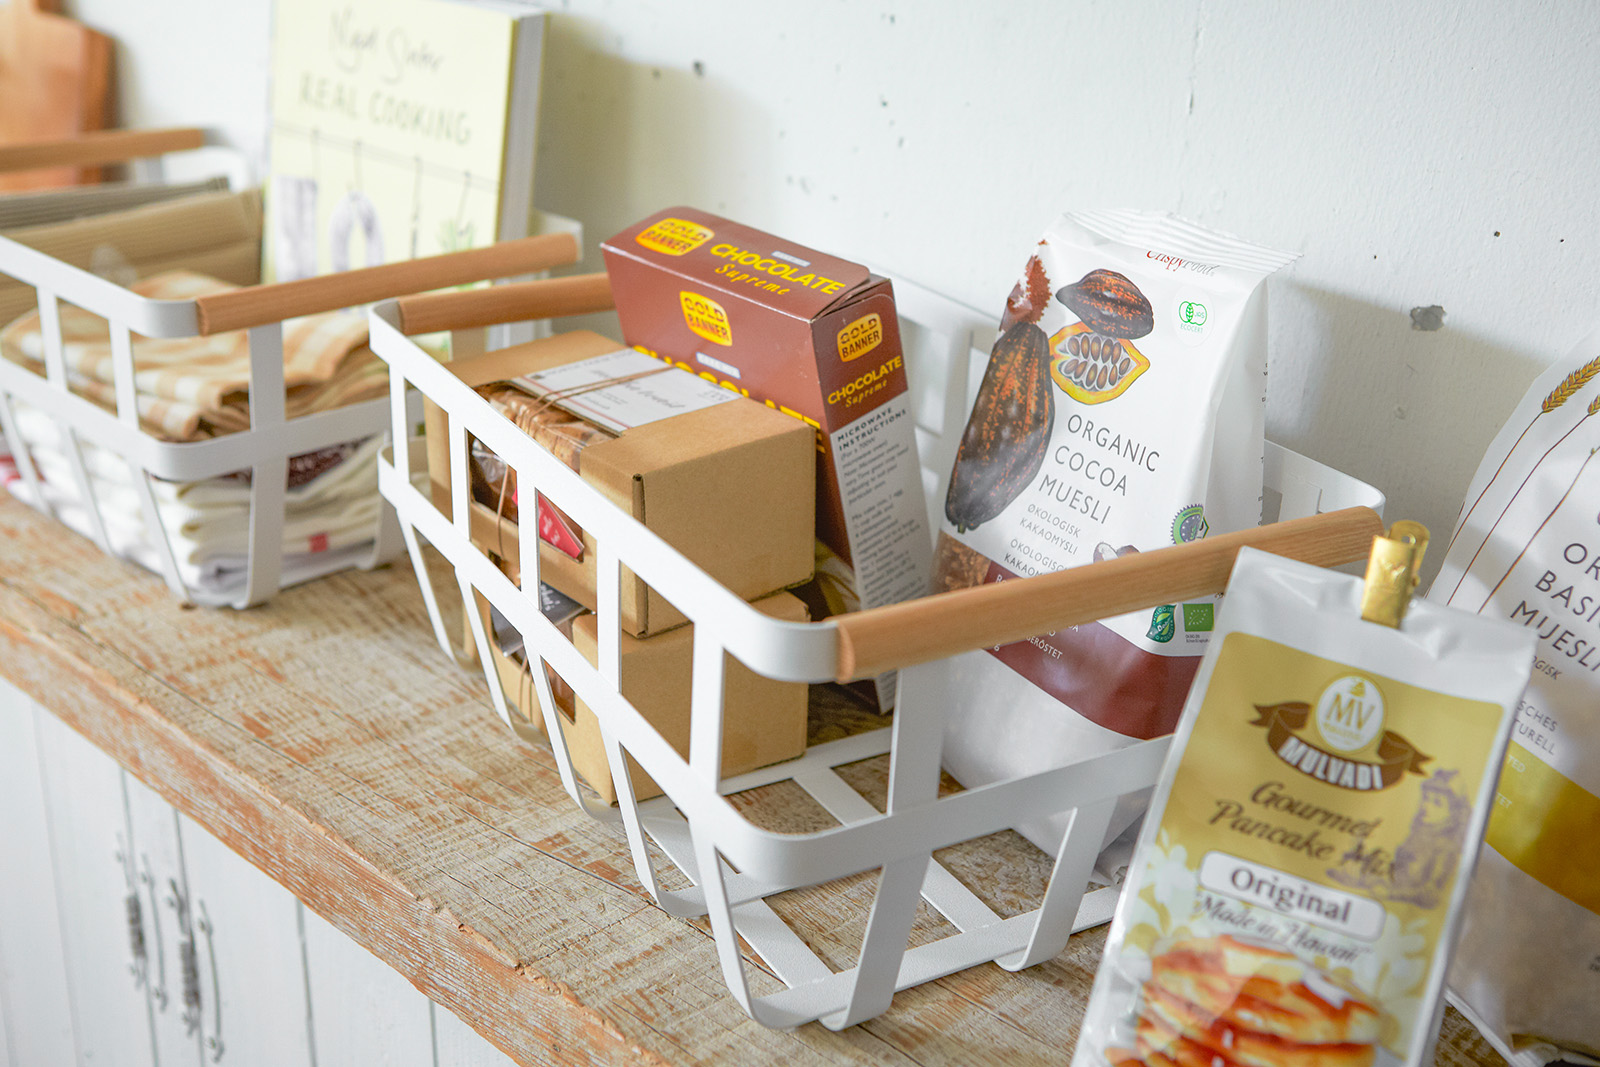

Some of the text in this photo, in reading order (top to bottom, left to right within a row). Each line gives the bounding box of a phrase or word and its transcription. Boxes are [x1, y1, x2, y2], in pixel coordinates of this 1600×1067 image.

[298, 71, 472, 146] REAL COOKING
[641, 229, 692, 253] BANNER
[658, 221, 707, 241] GOLD
[710, 243, 845, 296] CHOCOLATE
[714, 263, 791, 296] Supreme
[683, 297, 724, 323] GOLD
[686, 312, 730, 341] BANNER
[840, 316, 878, 345] GOLD
[840, 329, 881, 359] BANNER
[827, 355, 903, 406] CHOCOLATE
[845, 379, 888, 408] Supreme
[837, 407, 892, 442] MICROWAVE
[838, 408, 907, 452] INSTRUCTIONS
[1067, 414, 1160, 472] ORGANIC
[1054, 445, 1127, 497] COCOA
[1038, 474, 1112, 525] MUESLI
[1019, 517, 1079, 555] KAKAOMYSLI
[1027, 503, 1081, 538] ØKOLOGISK
[1563, 543, 1600, 581] OR
[1326, 693, 1376, 731] MV
[1278, 735, 1384, 790] MULVADI
[1251, 781, 1383, 838] Gourmet
[1209, 799, 1336, 860] Pancake
[1231, 866, 1352, 923] Original
